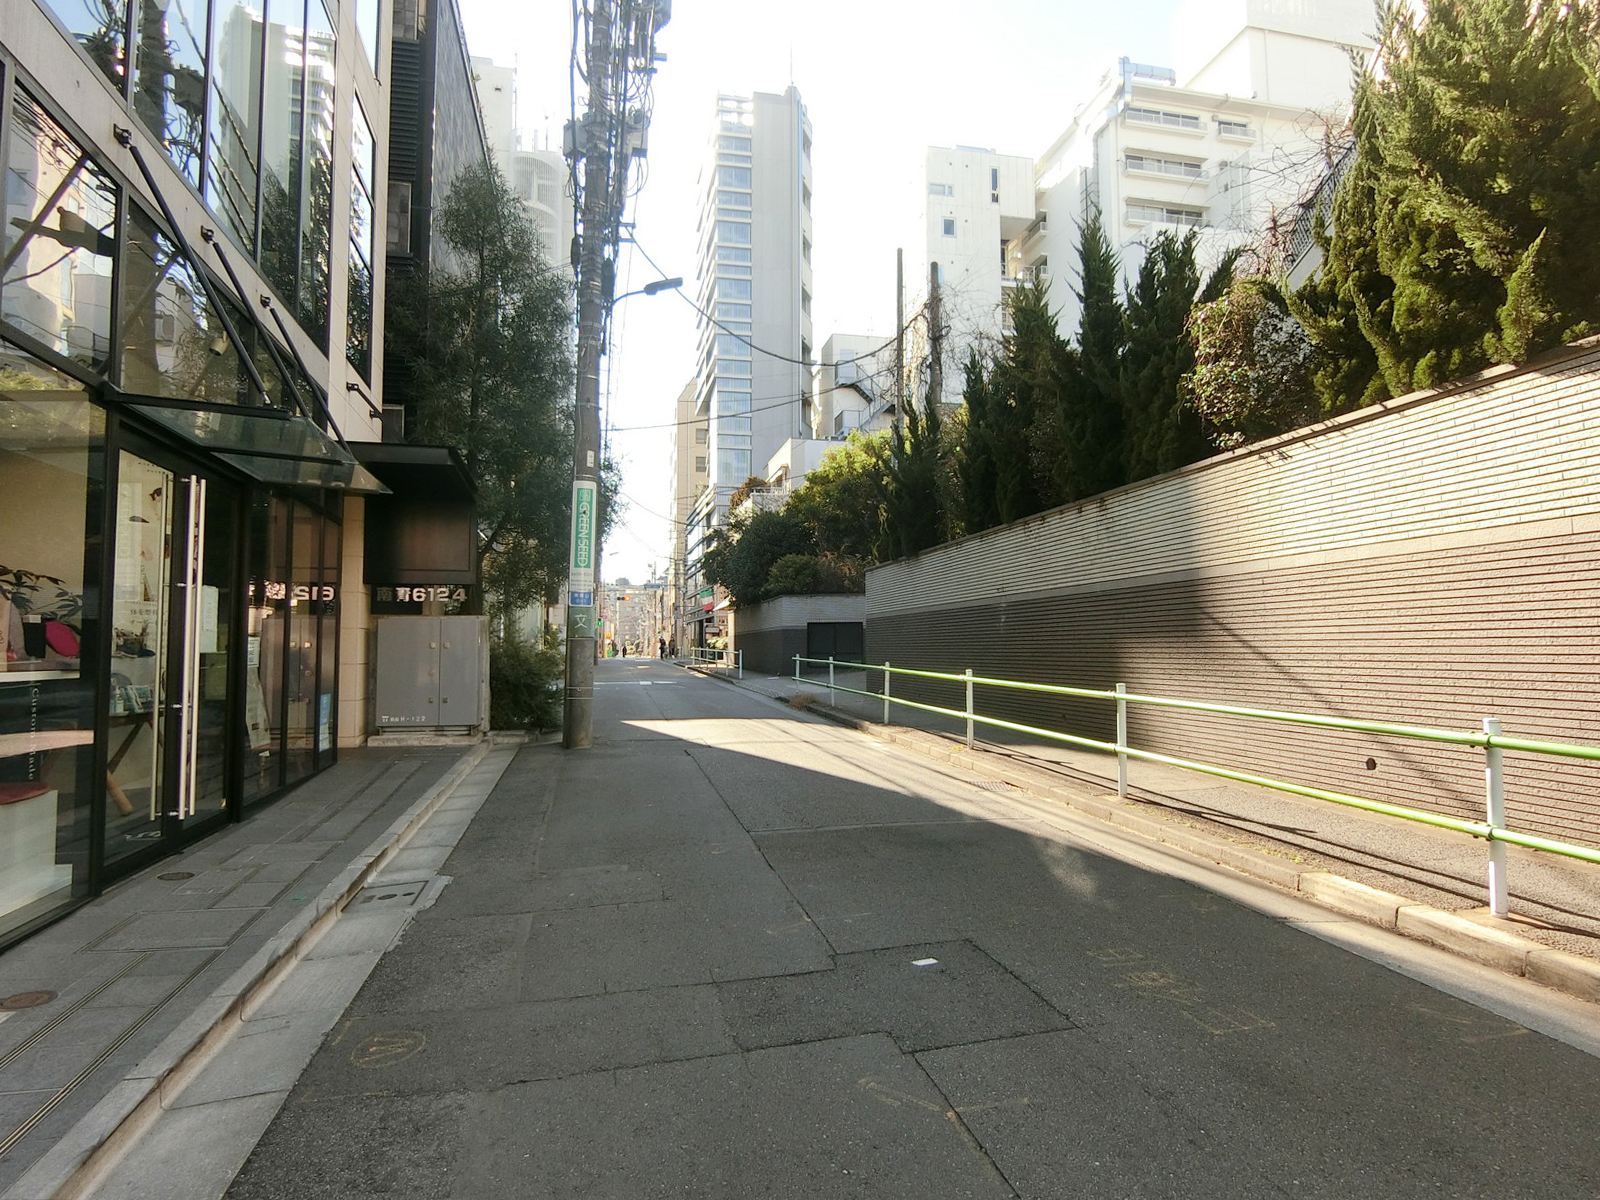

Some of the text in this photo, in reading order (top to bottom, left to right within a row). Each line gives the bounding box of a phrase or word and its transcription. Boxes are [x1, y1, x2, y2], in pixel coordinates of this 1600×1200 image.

[578, 502, 590, 537] GREEN
[577, 539, 589, 566] SEED
[28, 688, 39, 780] Custom Made
